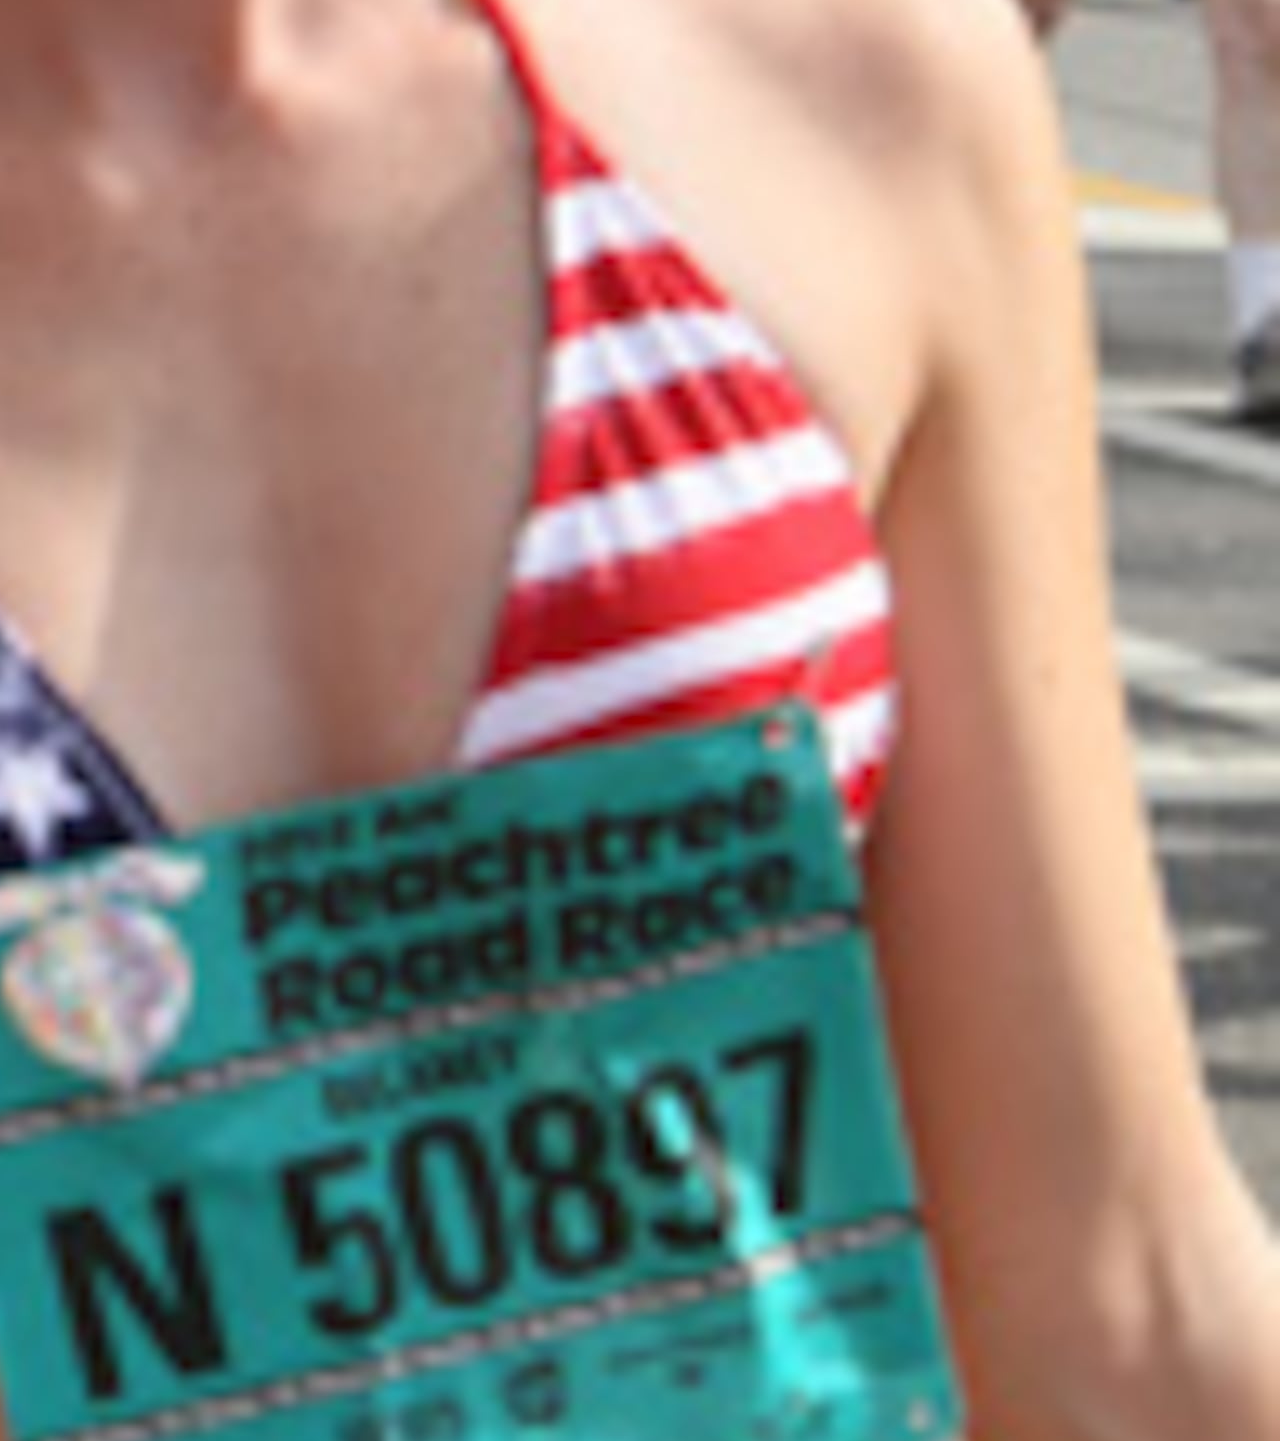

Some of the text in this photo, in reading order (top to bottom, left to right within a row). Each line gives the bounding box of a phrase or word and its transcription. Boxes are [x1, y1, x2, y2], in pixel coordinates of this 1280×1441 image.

[240, 771, 790, 946] Peachtree
[260, 853, 798, 1038] Road Race
[45, 1024, 816, 1403] N 50897
